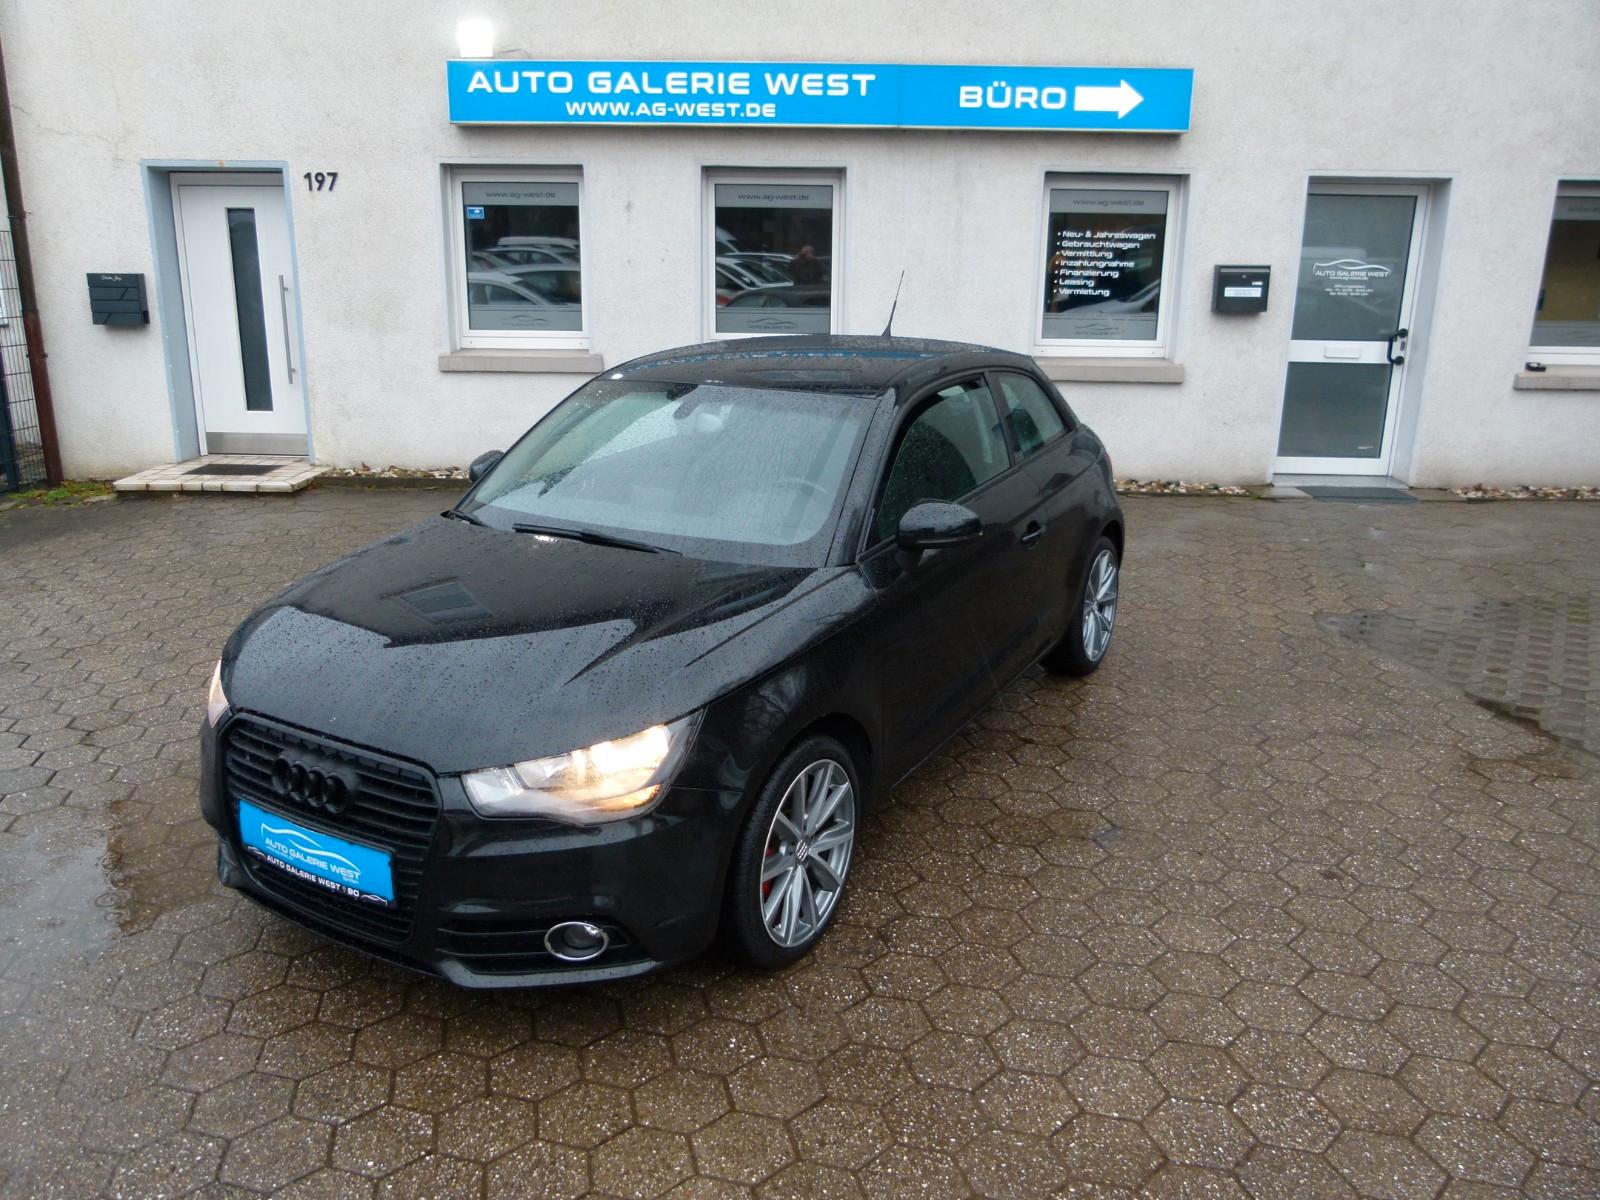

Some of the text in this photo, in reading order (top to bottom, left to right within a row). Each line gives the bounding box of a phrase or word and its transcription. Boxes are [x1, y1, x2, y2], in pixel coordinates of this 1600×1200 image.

[467, 71, 877, 97] AUTO GALERIE WEST
[959, 80, 1067, 109] BÜRO
[565, 101, 777, 118] WWW.AG-WEST.DE
[304, 172, 338, 192] 197
[485, 191, 556, 200] www.ag-west.de
[738, 193, 810, 202] www.ag-west.de
[1072, 198, 1145, 208] www.ag-west.de
[1093, 231, 1156, 240] Jahreswagen
[1061, 240, 1140, 250] Gebrauchtwagen
[1060, 250, 1114, 259] Vermittlung
[1060, 260, 1136, 269] Inzahlungnahme
[1059, 269, 1119, 278] Finanzierung
[1058, 279, 1096, 288] Leasing
[1058, 288, 1110, 297] Vermietung
[265, 837, 289, 854] AUTO
[289, 849, 330, 871] GALERIE
[330, 864, 361, 880] WEST
[266, 855, 285, 869] AUTO
[285, 864, 318, 883] GALERIE
[318, 877, 341, 890] WEST
